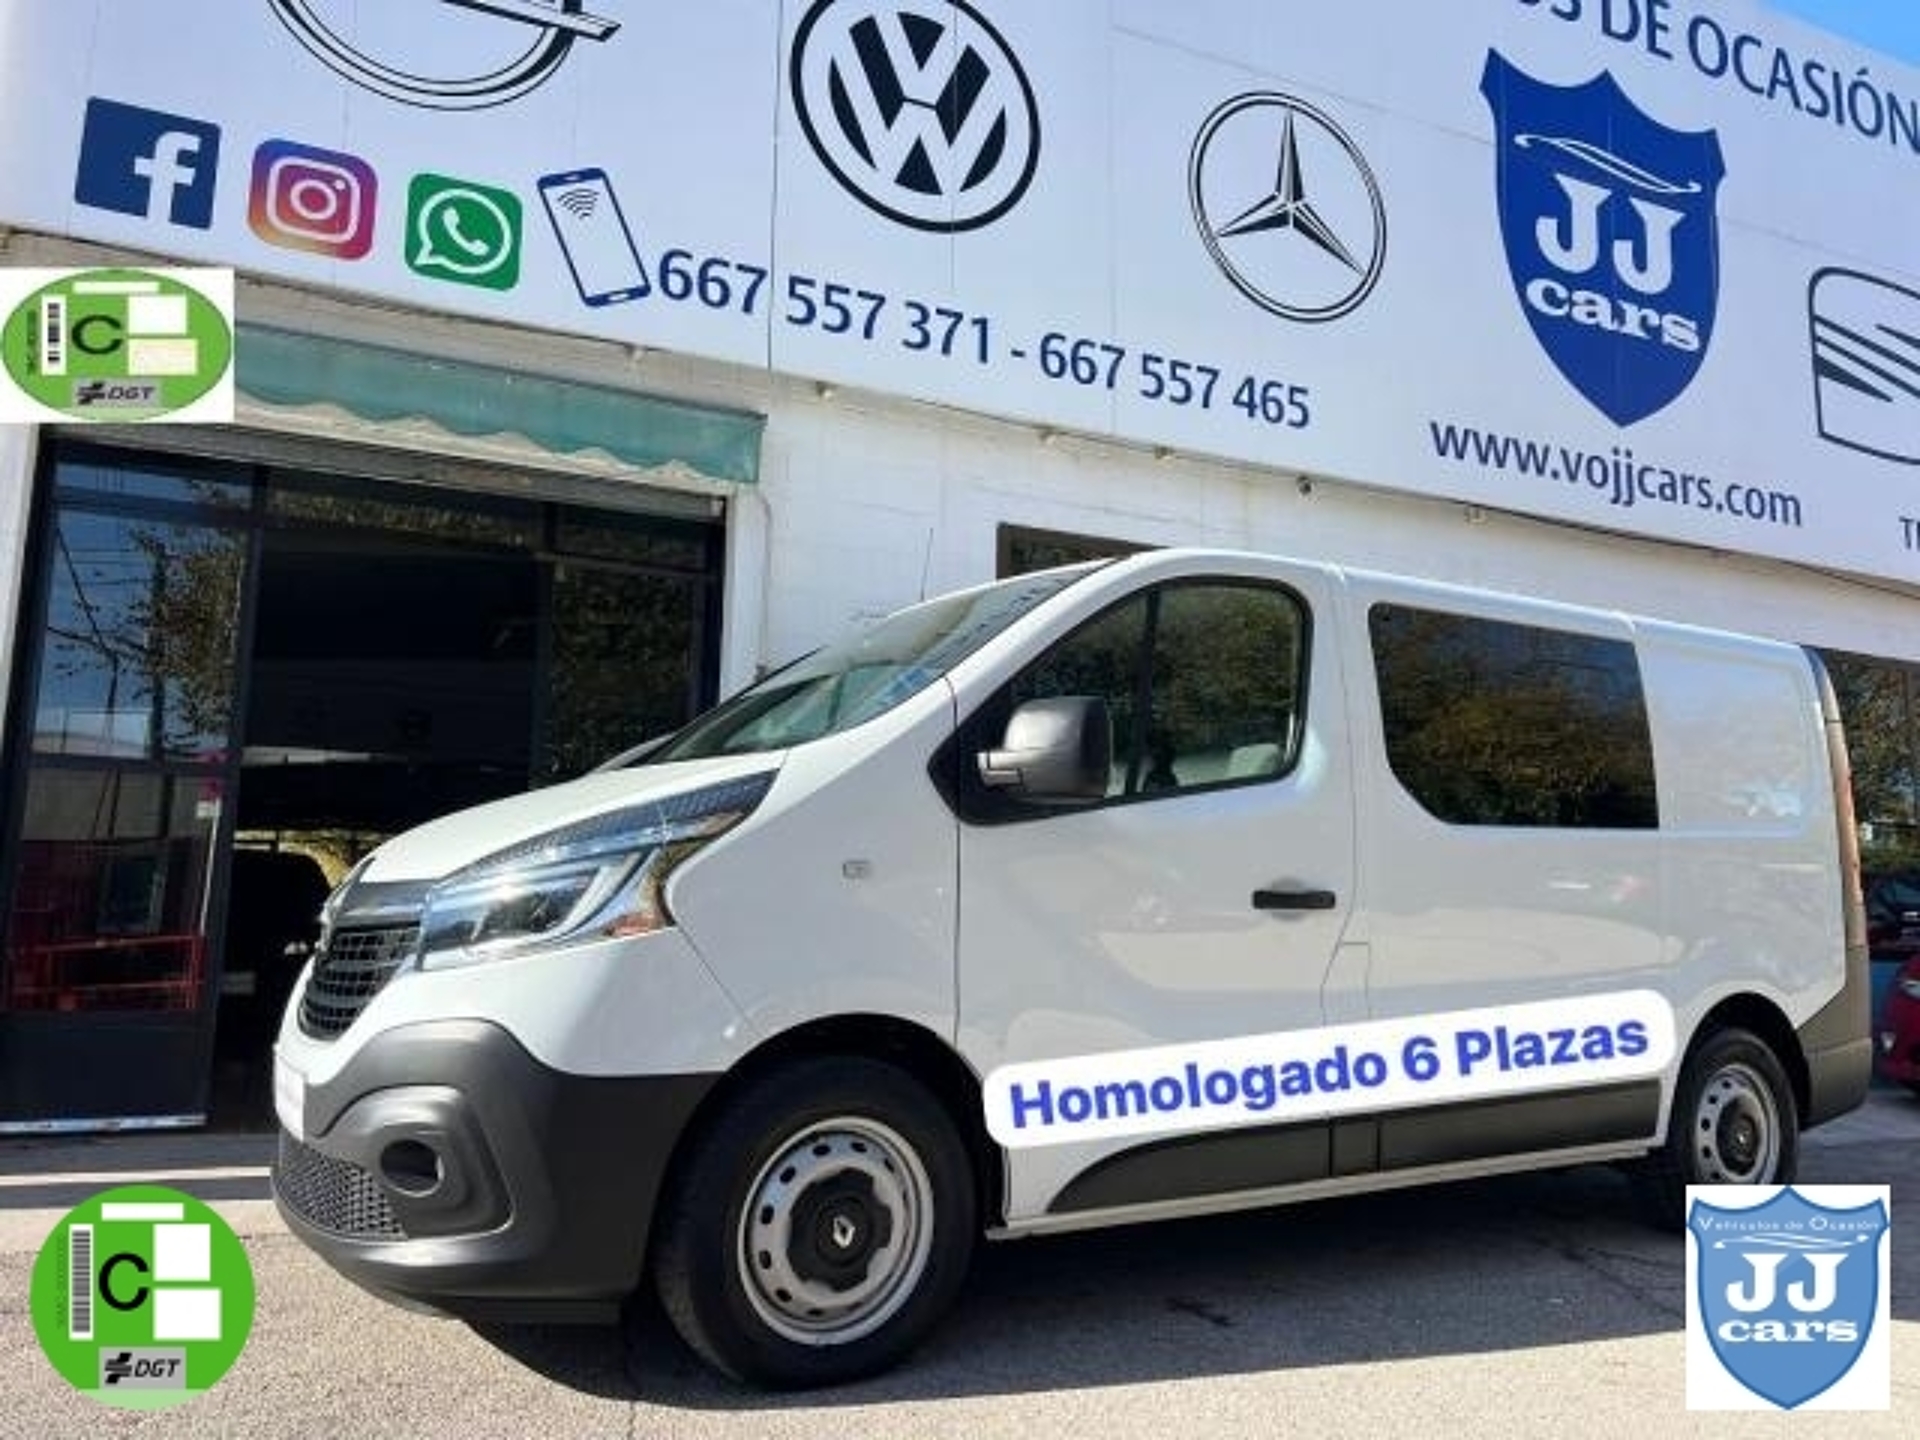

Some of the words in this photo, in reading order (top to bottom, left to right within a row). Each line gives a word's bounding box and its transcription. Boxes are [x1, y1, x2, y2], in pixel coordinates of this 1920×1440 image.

[1601, 0, 1674, 61] DE
[1688, 14, 1920, 155] OCASIÓN
[1535, 173, 1686, 295] JJ
[658, 249, 768, 315] 667
[786, 274, 886, 340] 557
[902, 300, 989, 364] 371
[1039, 332, 1126, 389] 667
[1140, 353, 1220, 408] 557
[1232, 376, 1310, 428] 465
[1526, 278, 1701, 353] cars
[1430, 421, 1802, 527] www.vojjcars.com
